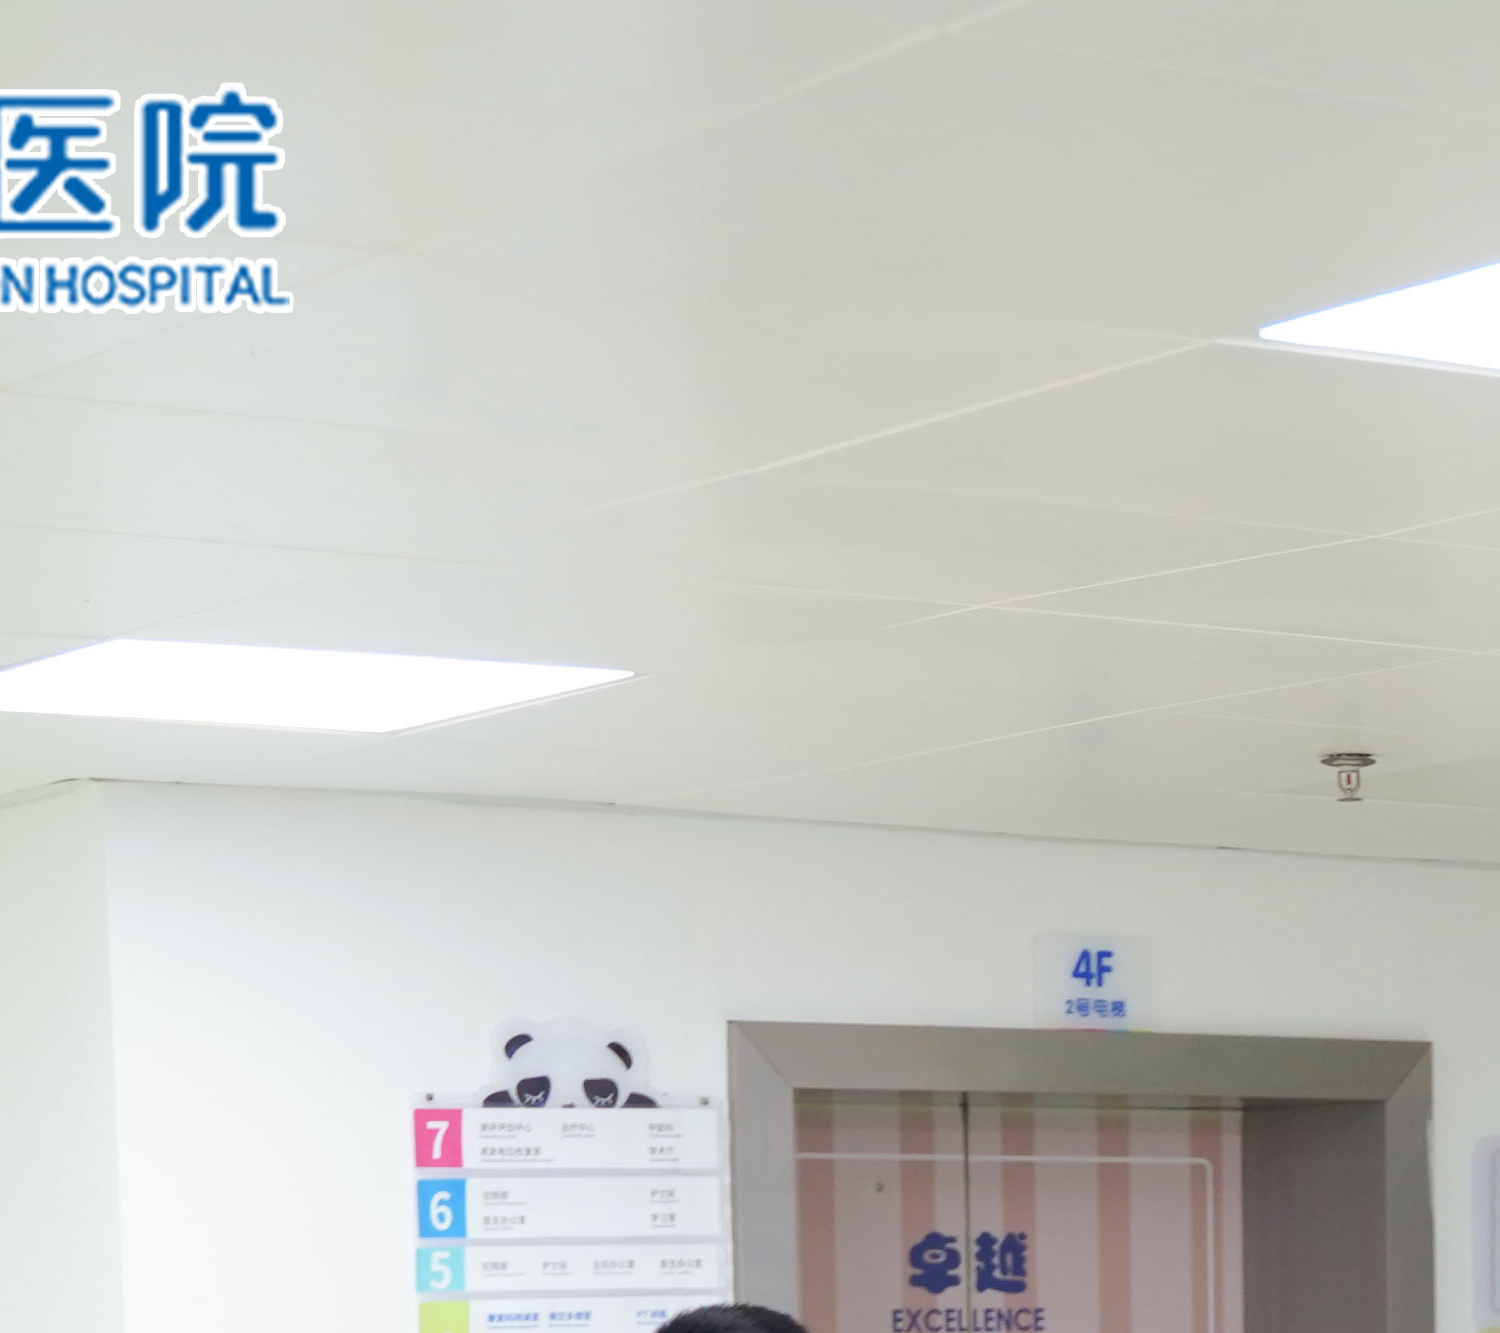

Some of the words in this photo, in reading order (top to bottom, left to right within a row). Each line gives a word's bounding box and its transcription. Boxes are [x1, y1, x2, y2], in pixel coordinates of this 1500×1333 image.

[1071, 949, 1116, 987] 4F
[425, 1120, 450, 1160] 7
[429, 1190, 454, 1231] 6
[429, 1251, 453, 1290] 5
[909, 1231, 1028, 1294] 卓越
[891, 1307, 1046, 1333] EXCELLENCE
